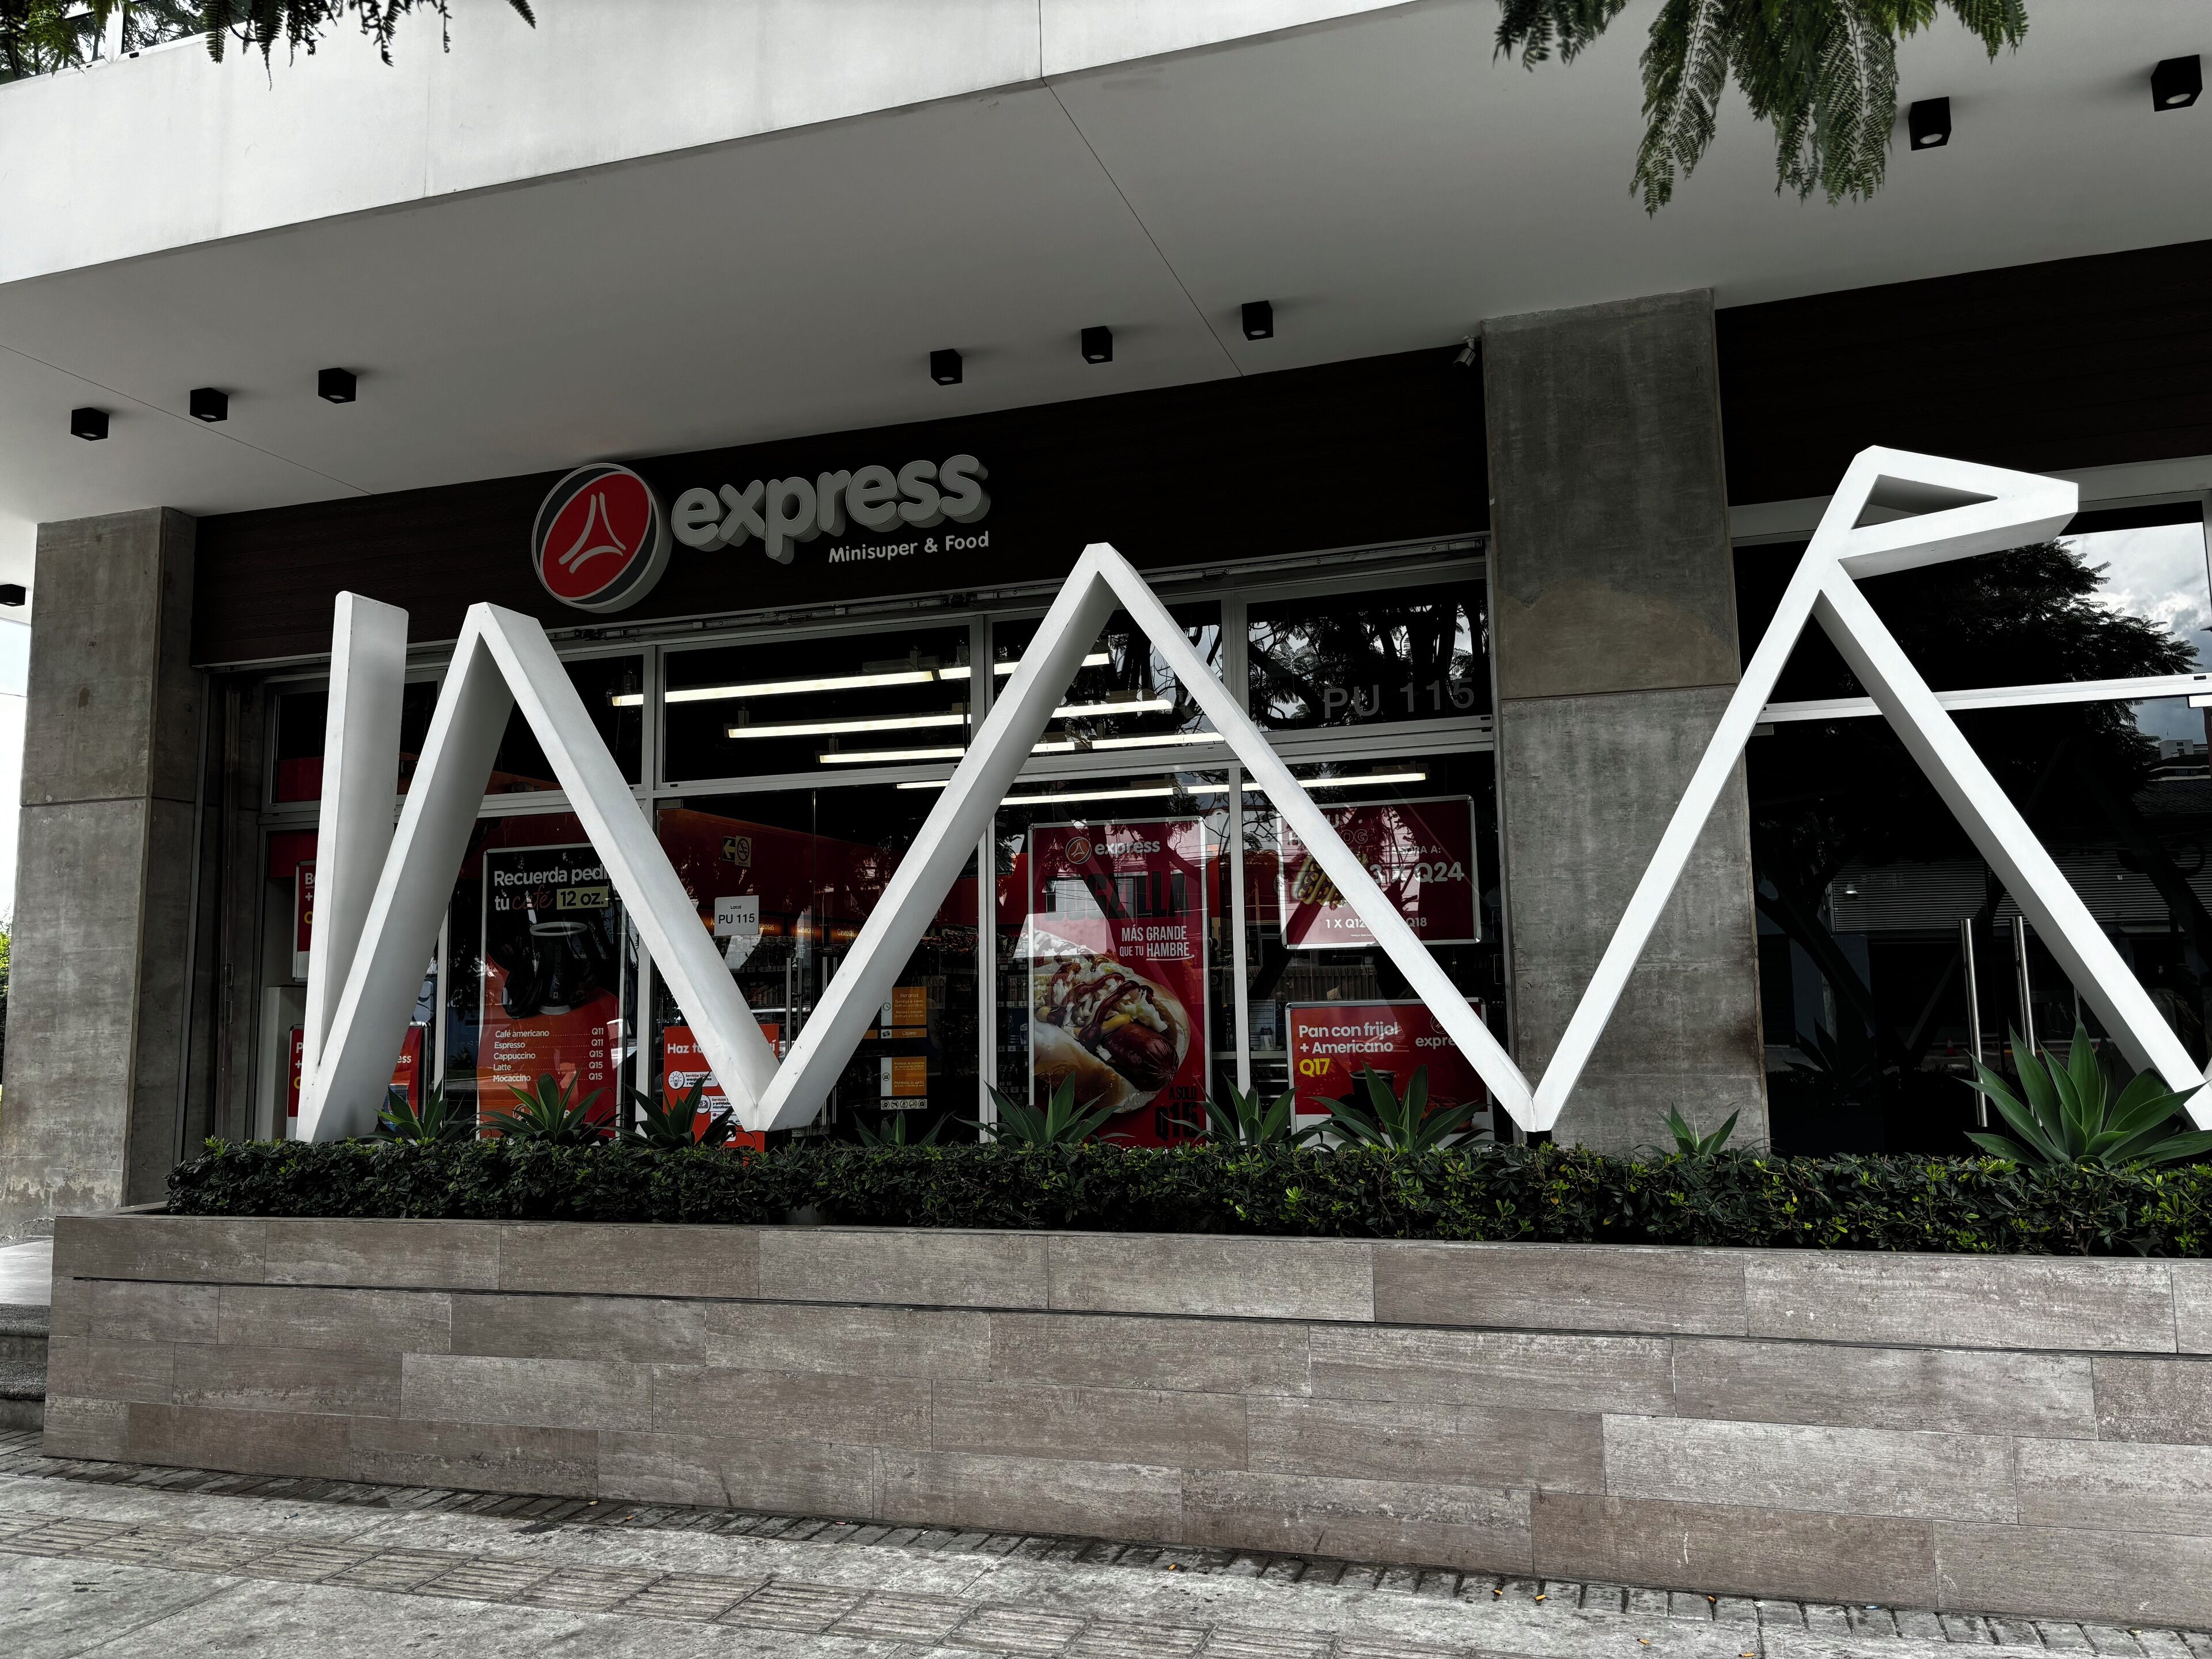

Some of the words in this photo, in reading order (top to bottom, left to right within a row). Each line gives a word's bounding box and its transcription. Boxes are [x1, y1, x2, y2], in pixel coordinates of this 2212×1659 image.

[671, 454, 991, 565] express
[828, 541, 918, 563] Minisuper
[924, 537, 938, 554] &
[945, 530, 989, 551] Food
[1325, 684, 1380, 719] PU
[1400, 677, 1475, 713] 115
[1094, 840, 1161, 857] express
[494, 866, 567, 887] Recuerda
[571, 863, 611, 884] pedi
[1414, 861, 1464, 884] Q24
[512, 884, 554, 911] café
[560, 891, 577, 907] 12
[580, 892, 604, 906] oz.
[718, 914, 733, 925] PU
[736, 913, 755, 923] 115
[1325, 919, 1330, 929] 1
[1334, 919, 1342, 928] X
[1121, 924, 1143, 942] MÁS
[1146, 925, 1187, 941] GRANDE
[1119, 946, 1134, 957] QUE
[1135, 946, 1144, 956] TU
[1146, 942, 1190, 957] HAMBRE
[495, 1029, 511, 1037] Café
[513, 1029, 550, 1037] americano
[591, 1028, 604, 1036] Q11
[1299, 1025, 1329, 1038] Pan
[1331, 1025, 1361, 1036] con
[1363, 1021, 1399, 1040] frijol
[494, 1041, 525, 1050] Espresso
[591, 1039, 604, 1047] Q11
[667, 1043, 690, 1054] Haz
[1312, 1040, 1393, 1054] Americano
[1415, 1037, 1456, 1050] expre
[494, 1052, 536, 1061] Cappuccino
[589, 1050, 604, 1059] Q15
[589, 1061, 603, 1070] Q15
[1299, 1058, 1330, 1077] Q17
[493, 1074, 531, 1082] Mocaccino
[588, 1073, 603, 1081] Q15
